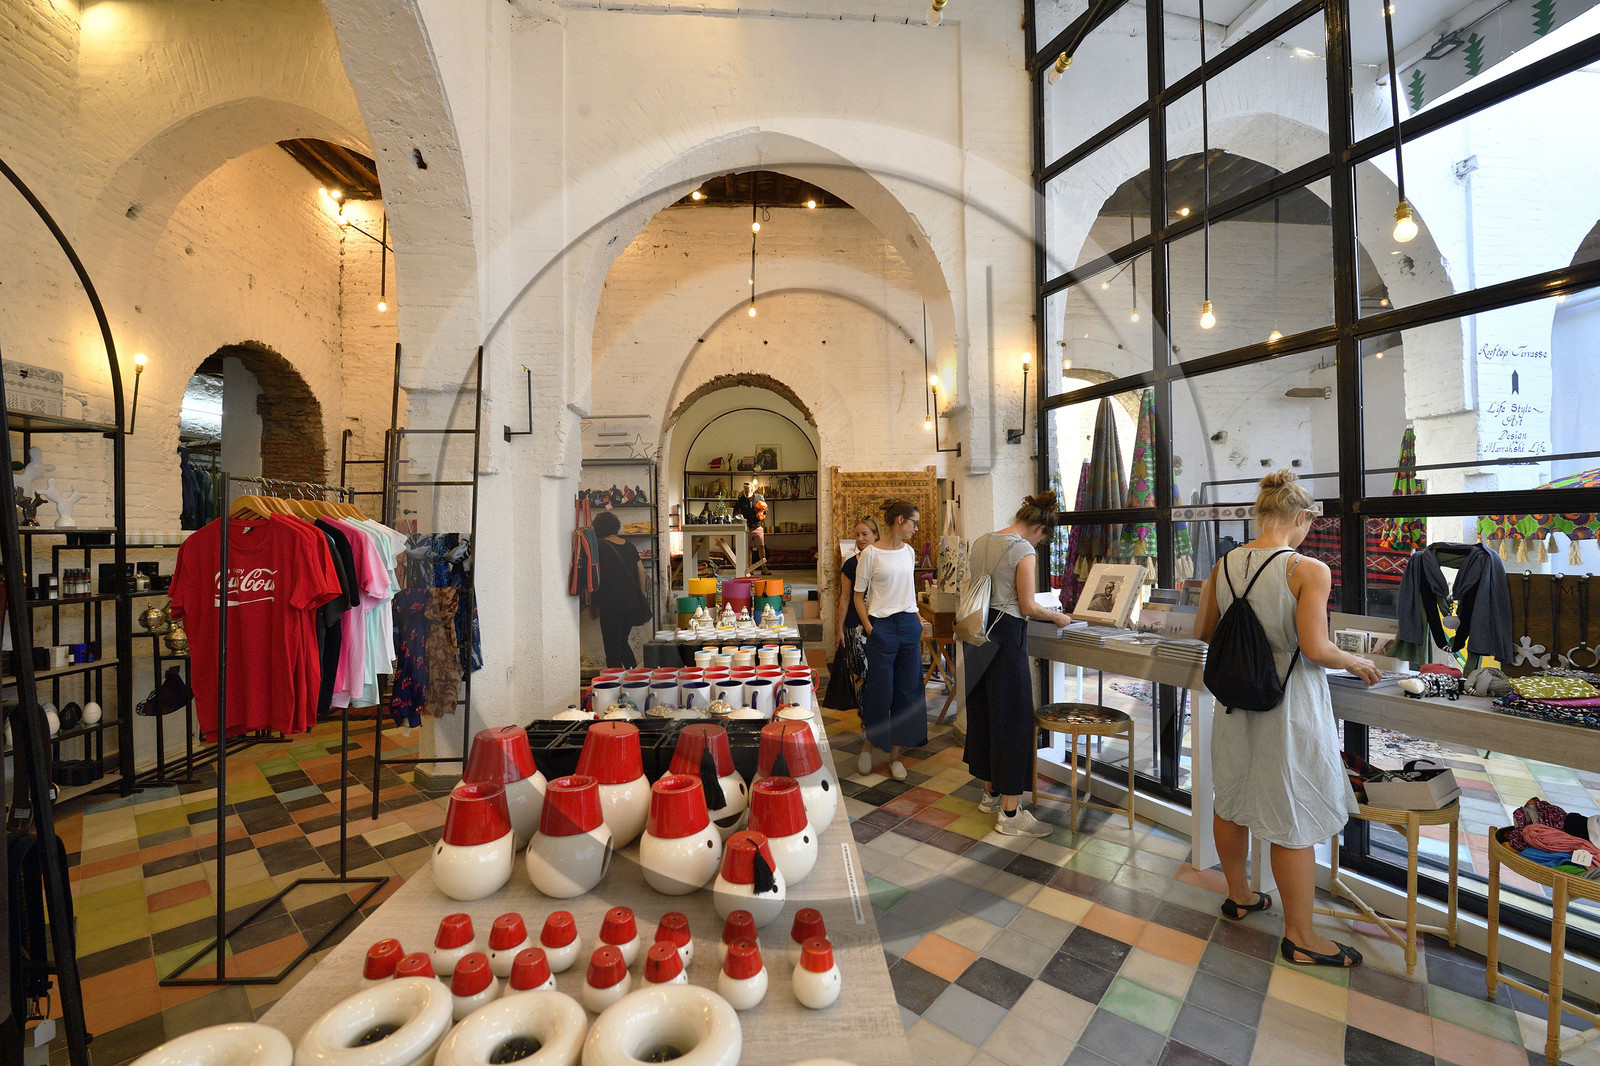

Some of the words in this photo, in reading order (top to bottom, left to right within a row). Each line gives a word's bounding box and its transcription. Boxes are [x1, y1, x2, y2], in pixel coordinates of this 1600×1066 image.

[1478, 342, 1509, 360] Rooftop
[1511, 344, 1548, 359] Terrasse
[1487, 400, 1506, 417] Life
[1502, 415, 1523, 427] Art
[1498, 429, 1527, 443] Design
[1528, 441, 1546, 455] Life
